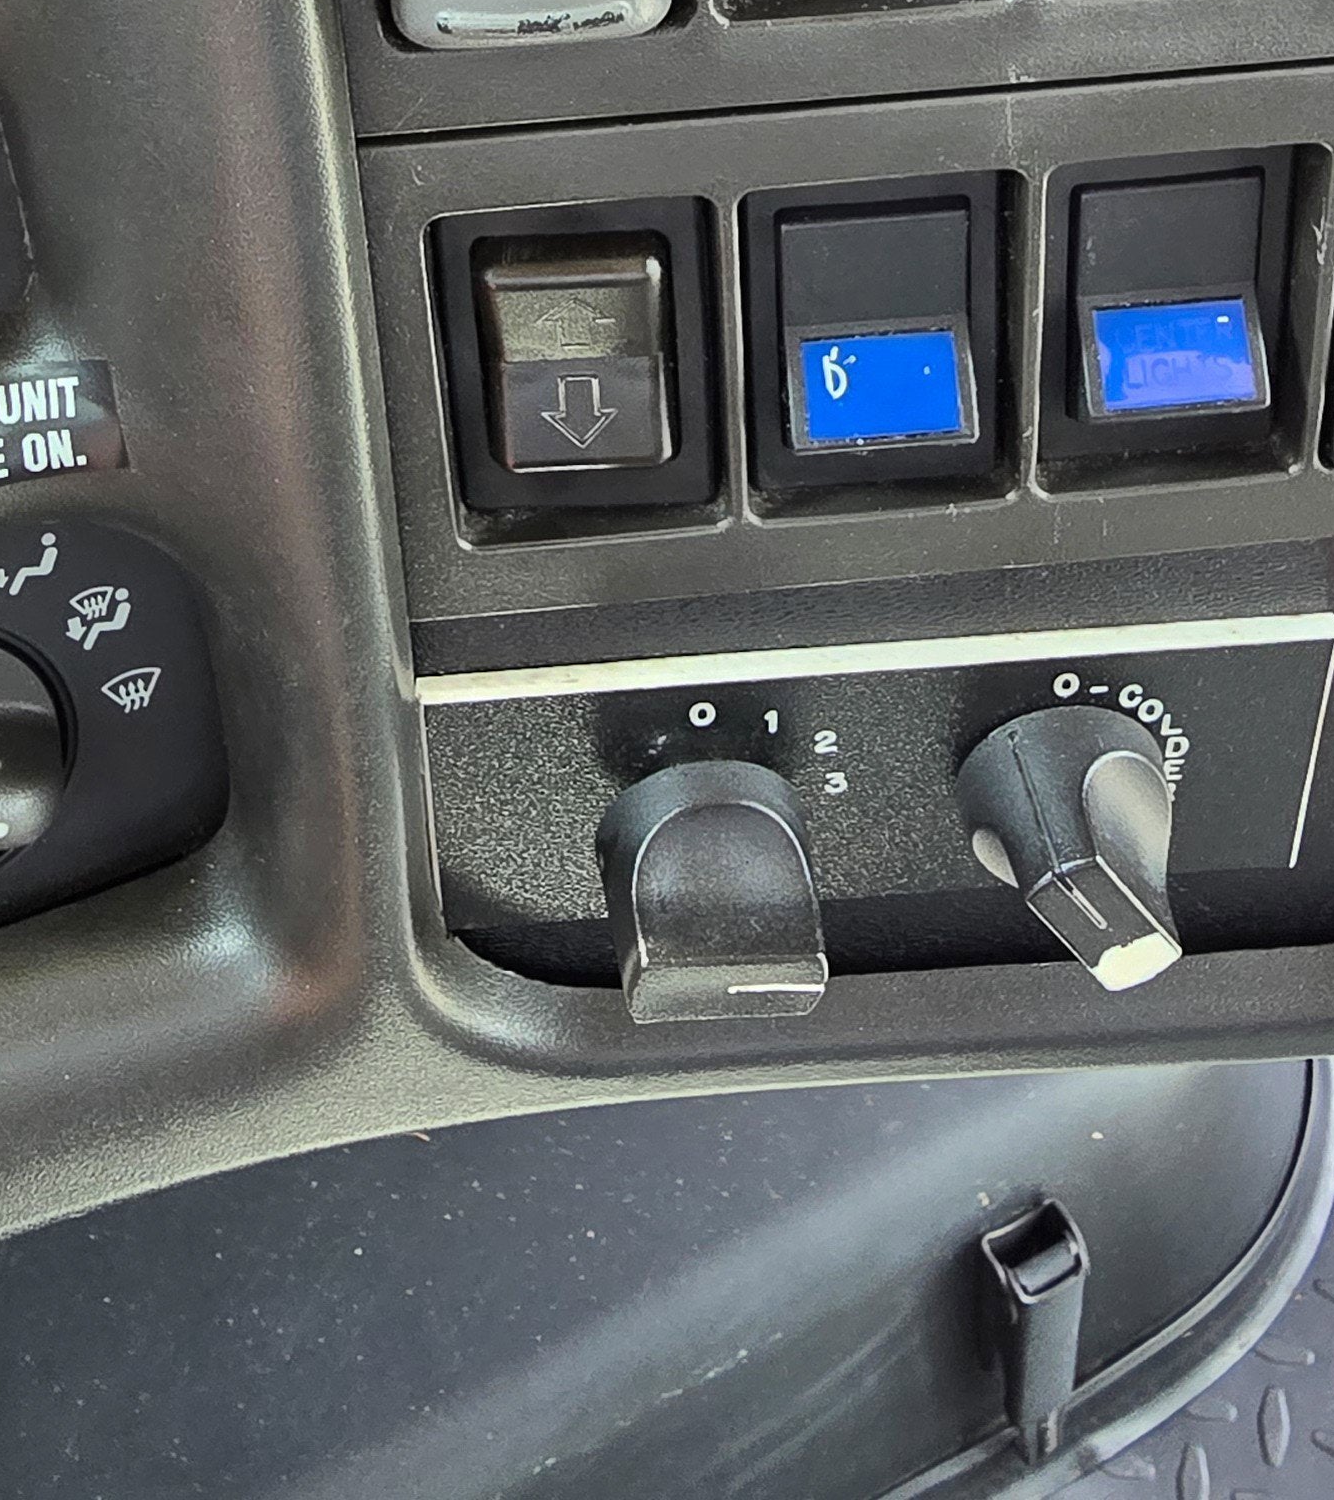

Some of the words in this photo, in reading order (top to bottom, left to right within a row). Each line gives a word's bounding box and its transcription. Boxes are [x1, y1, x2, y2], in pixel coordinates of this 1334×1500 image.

[22, 429, 87, 473] ON.
[764, 709, 778, 734] 1
[813, 729, 838, 754] 2
[823, 771, 848, 794] 3
